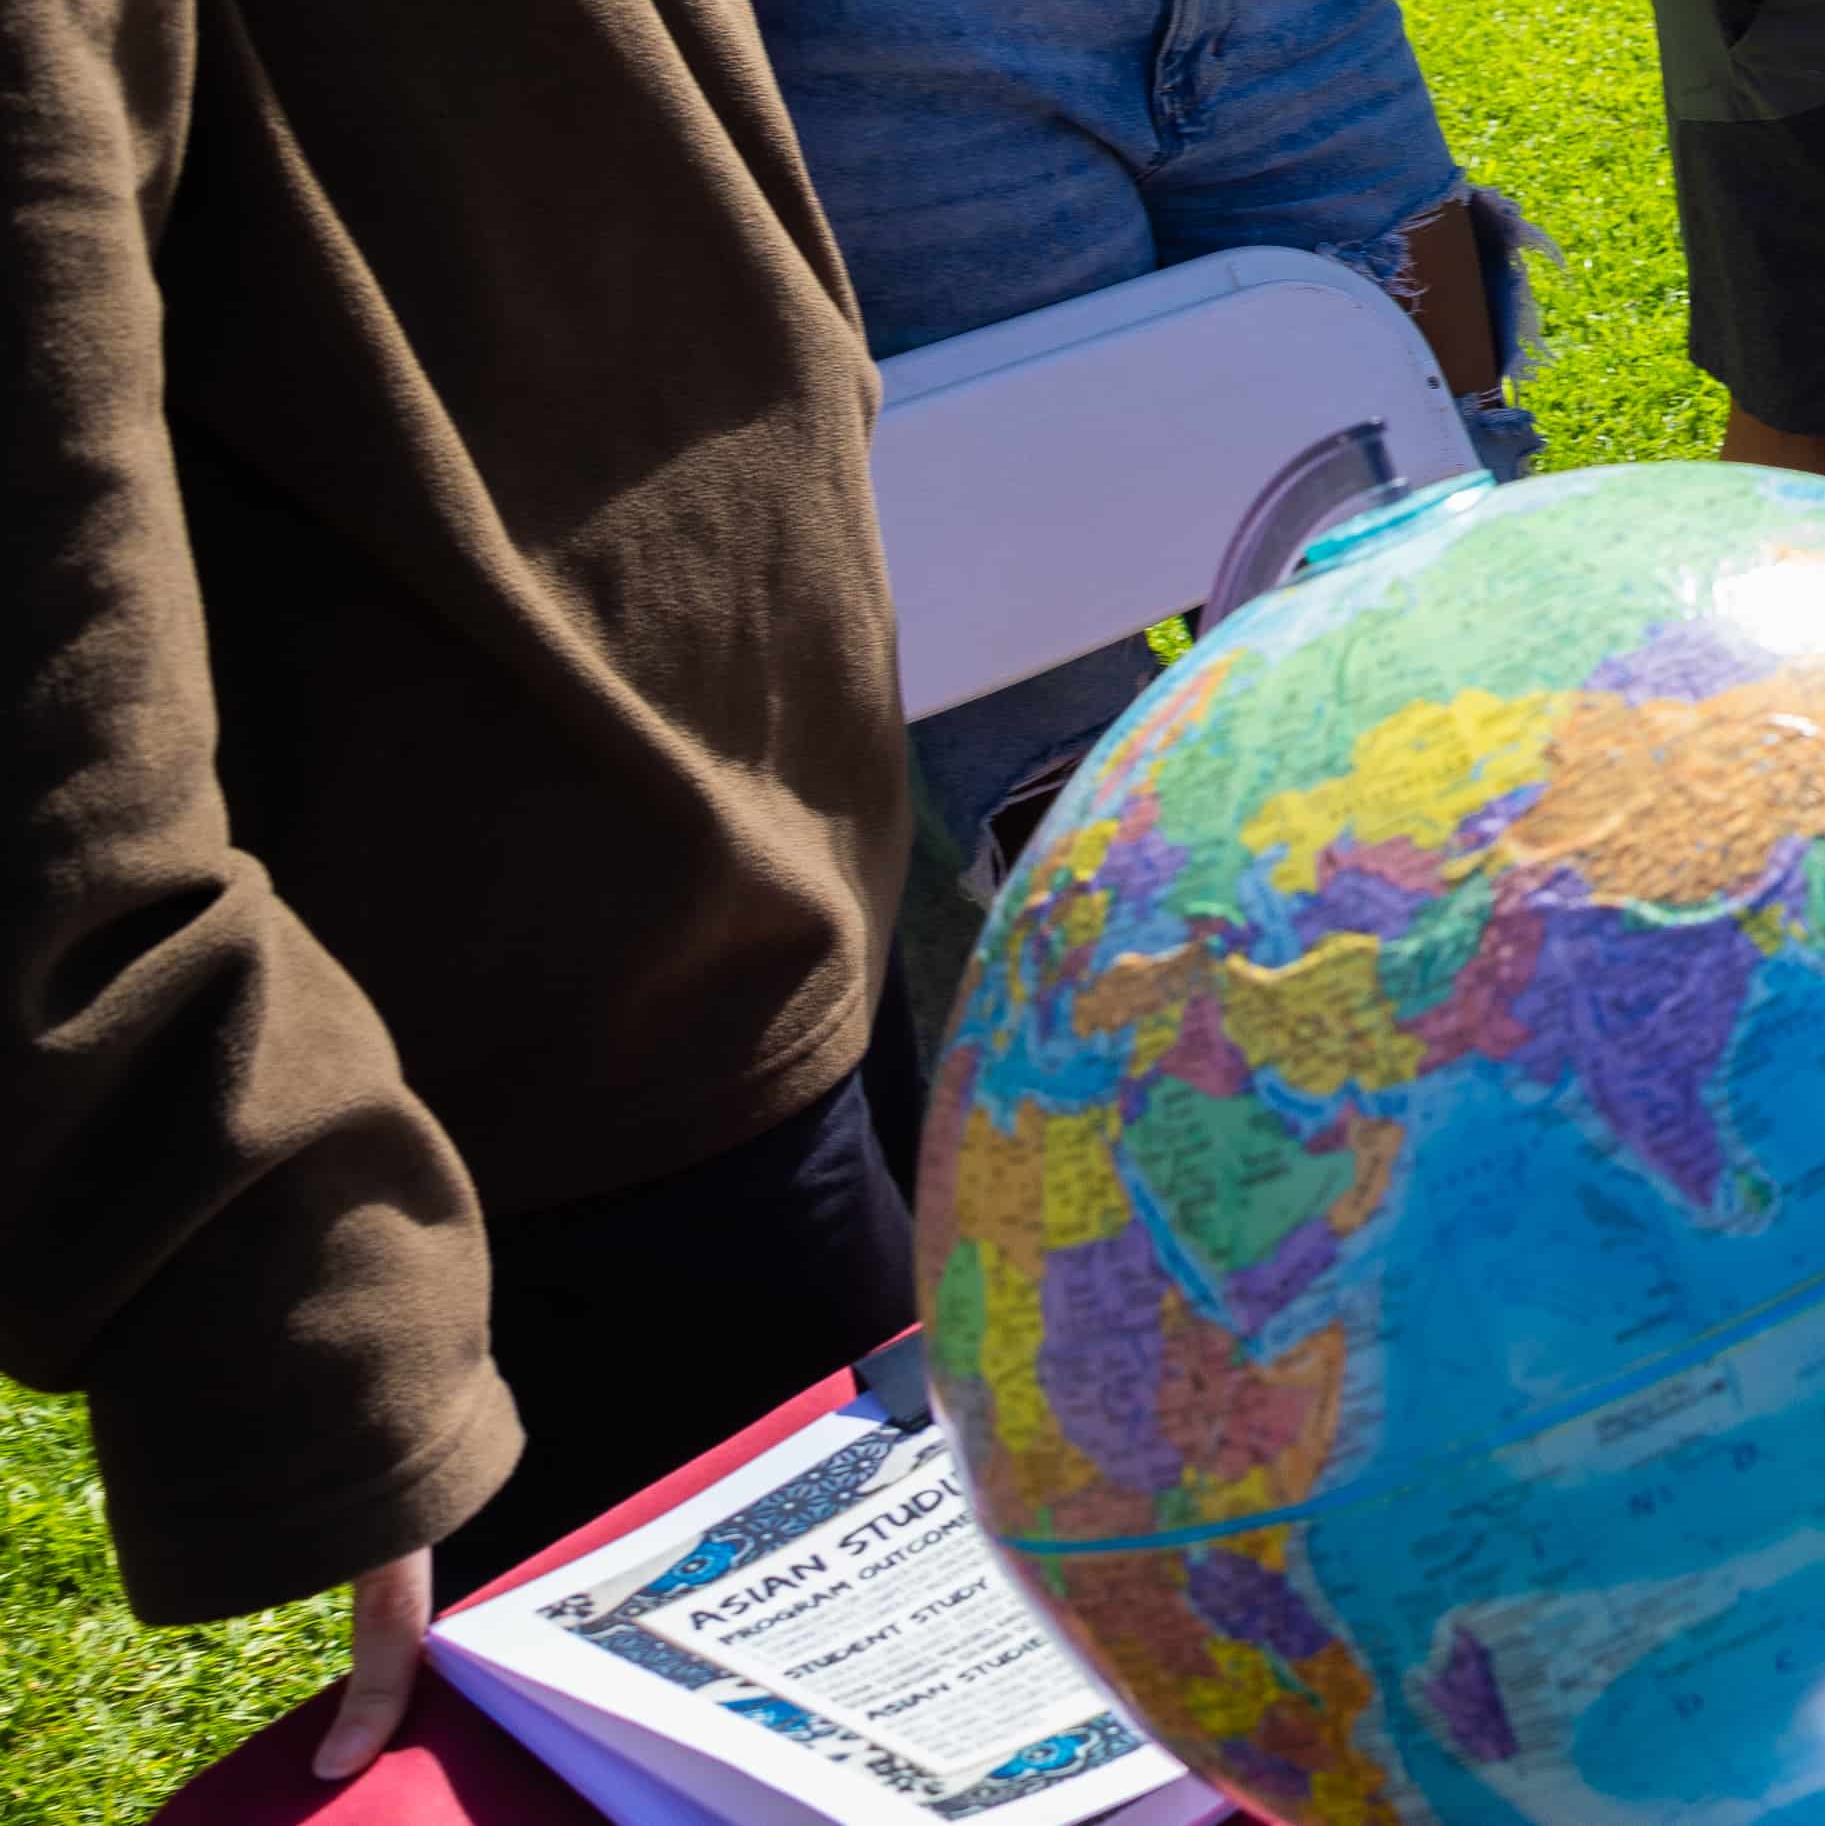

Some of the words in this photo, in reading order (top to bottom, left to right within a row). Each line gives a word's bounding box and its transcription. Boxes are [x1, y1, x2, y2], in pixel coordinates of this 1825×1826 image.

[688, 1552, 829, 1632] ASIAN
[837, 1474, 966, 1557] STUDI
[718, 1580, 853, 1645] PROGRAM
[783, 1621, 902, 1680] STUDENT
[909, 1575, 989, 1625] STUDY
[867, 1682, 950, 1721] ASIAN
